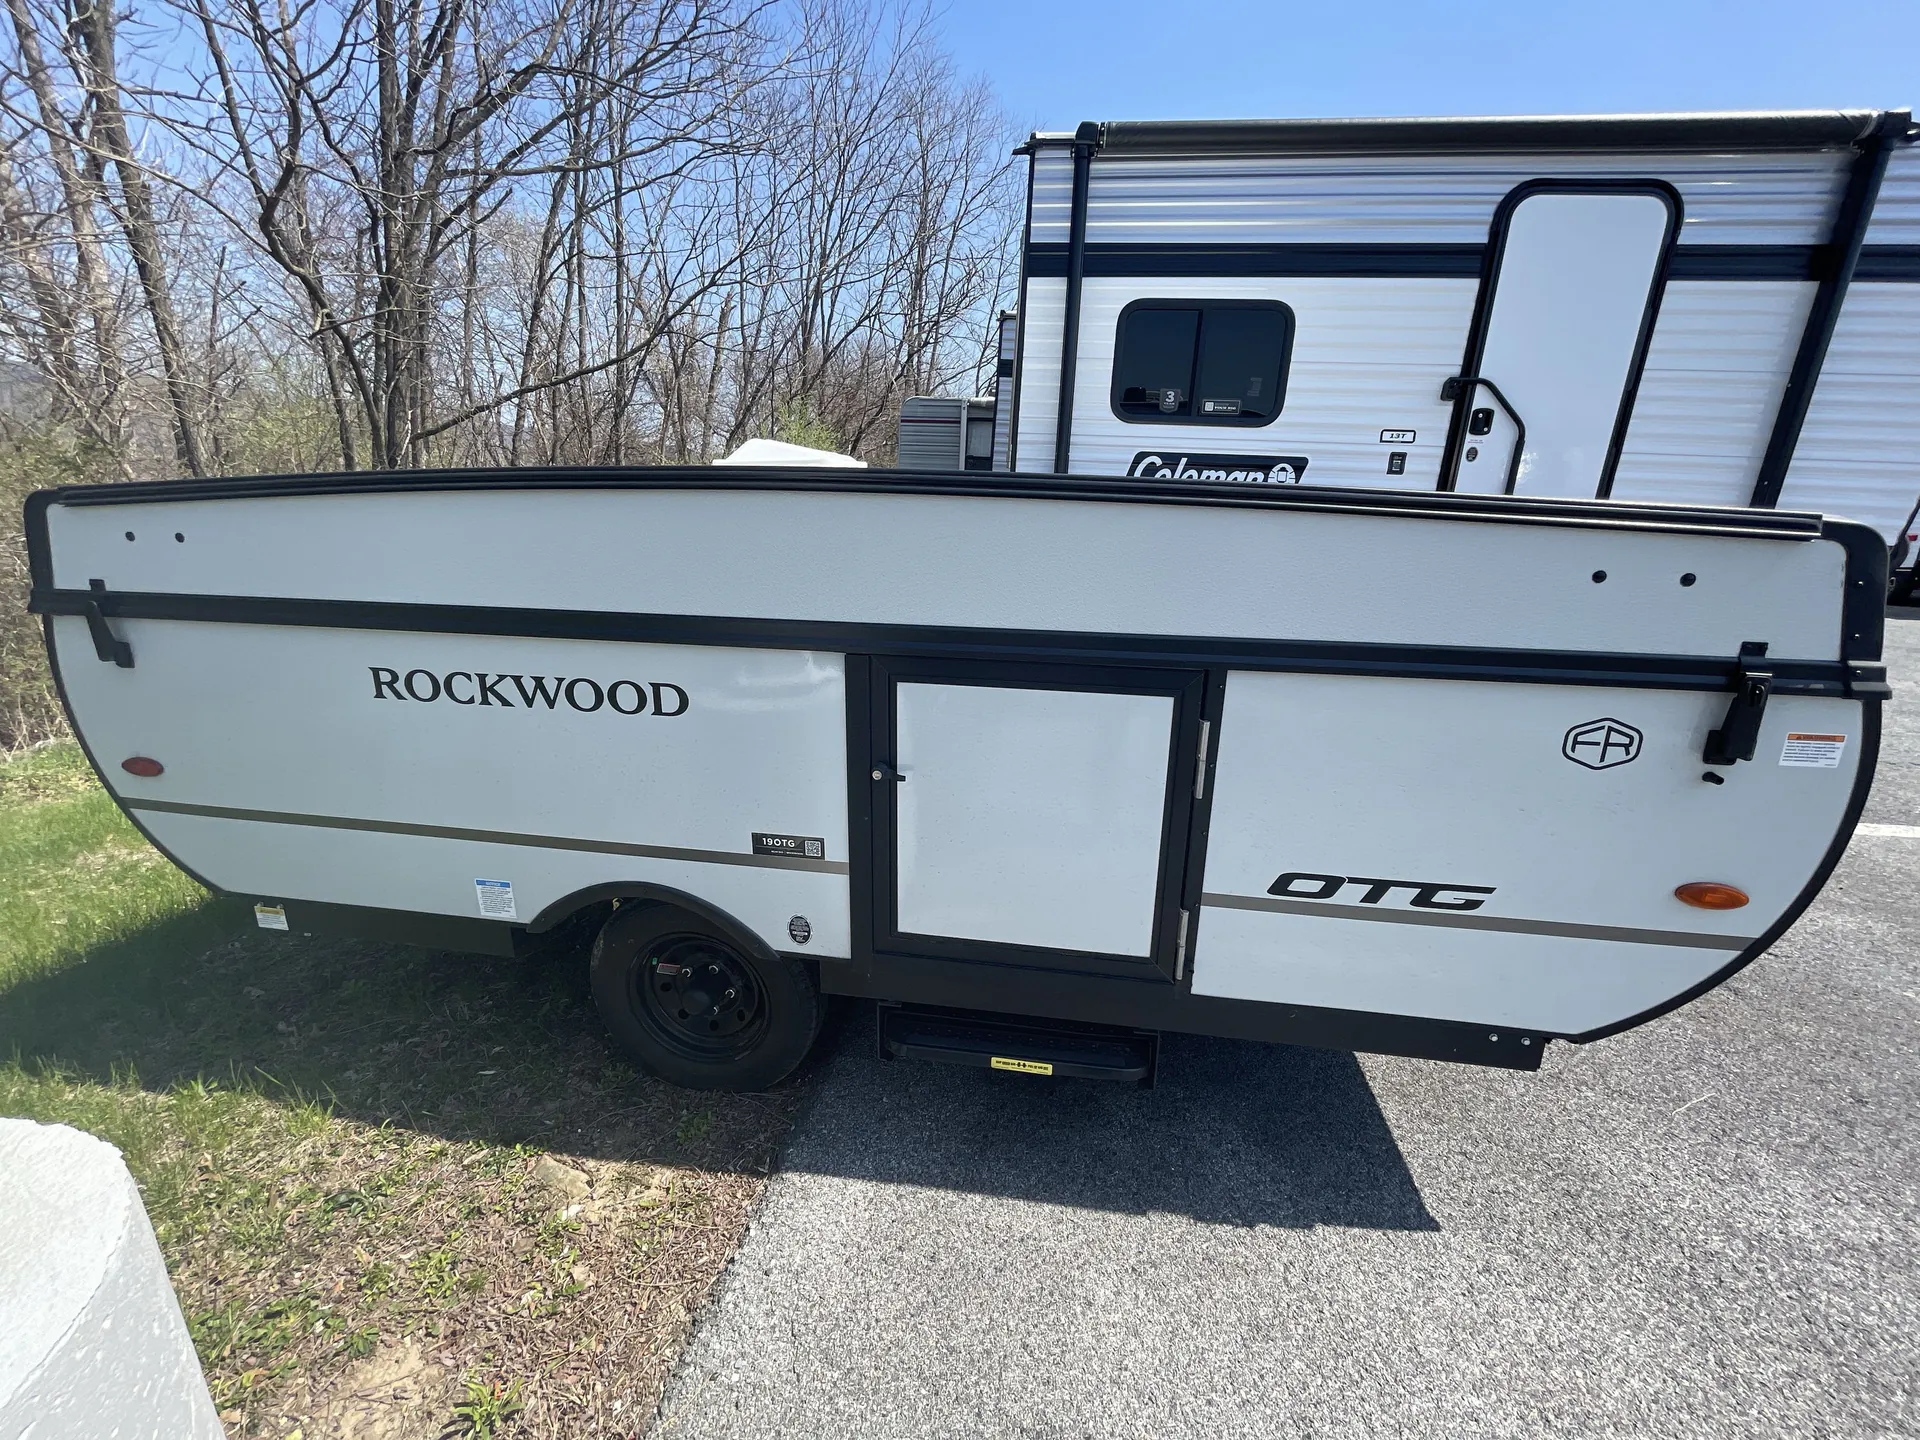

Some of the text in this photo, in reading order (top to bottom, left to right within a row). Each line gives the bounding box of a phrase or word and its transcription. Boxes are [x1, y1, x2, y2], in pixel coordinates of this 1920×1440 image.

[1165, 391, 1175, 402] 3
[368, 666, 690, 717] ROCKWOOD
[1266, 871, 1498, 911] OTG
